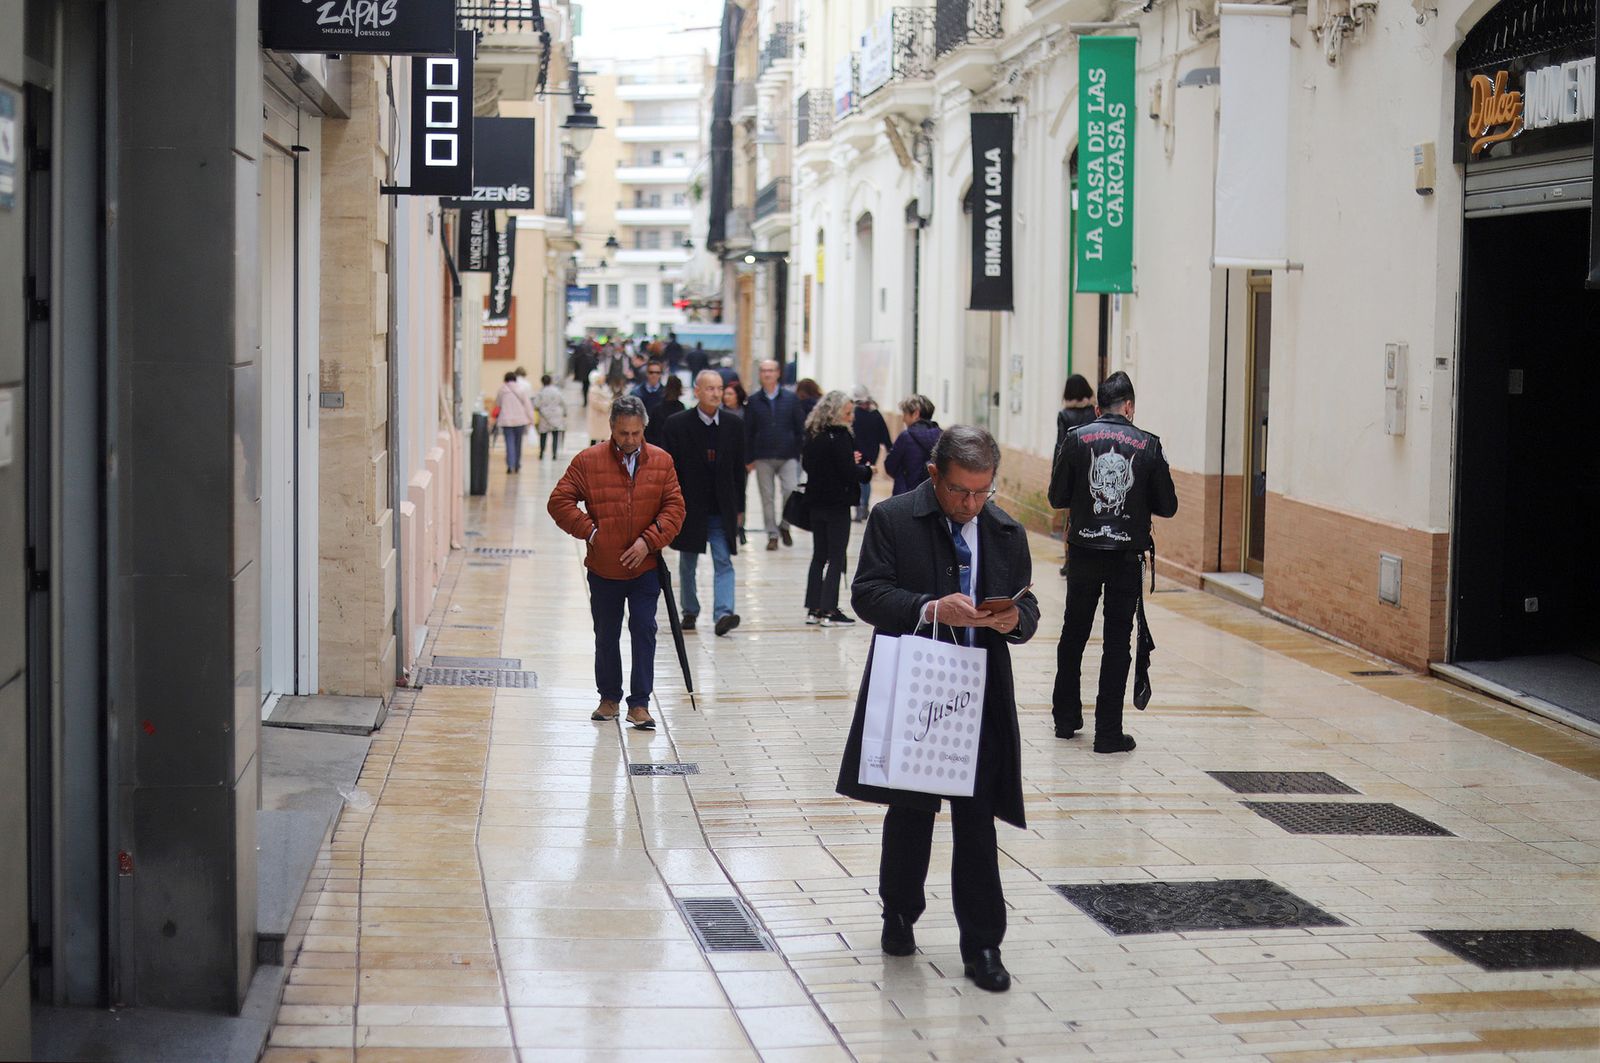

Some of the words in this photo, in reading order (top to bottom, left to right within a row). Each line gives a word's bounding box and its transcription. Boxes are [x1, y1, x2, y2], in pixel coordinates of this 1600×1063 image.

[1088, 68, 1106, 113] LAS
[1468, 70, 1524, 154] Dulce
[1088, 121, 1105, 153] DE
[985, 147, 1002, 196] LOLA
[1087, 157, 1104, 219] CASA
[1107, 103, 1126, 227] CARCASAS
[451, 184, 531, 201] ZENIS
[985, 198, 1002, 214] Y
[469, 236, 483, 270] LYNCIS
[985, 215, 1002, 277] BIMBA
[1085, 227, 1103, 261] LA
[914, 691, 971, 742] Justo
